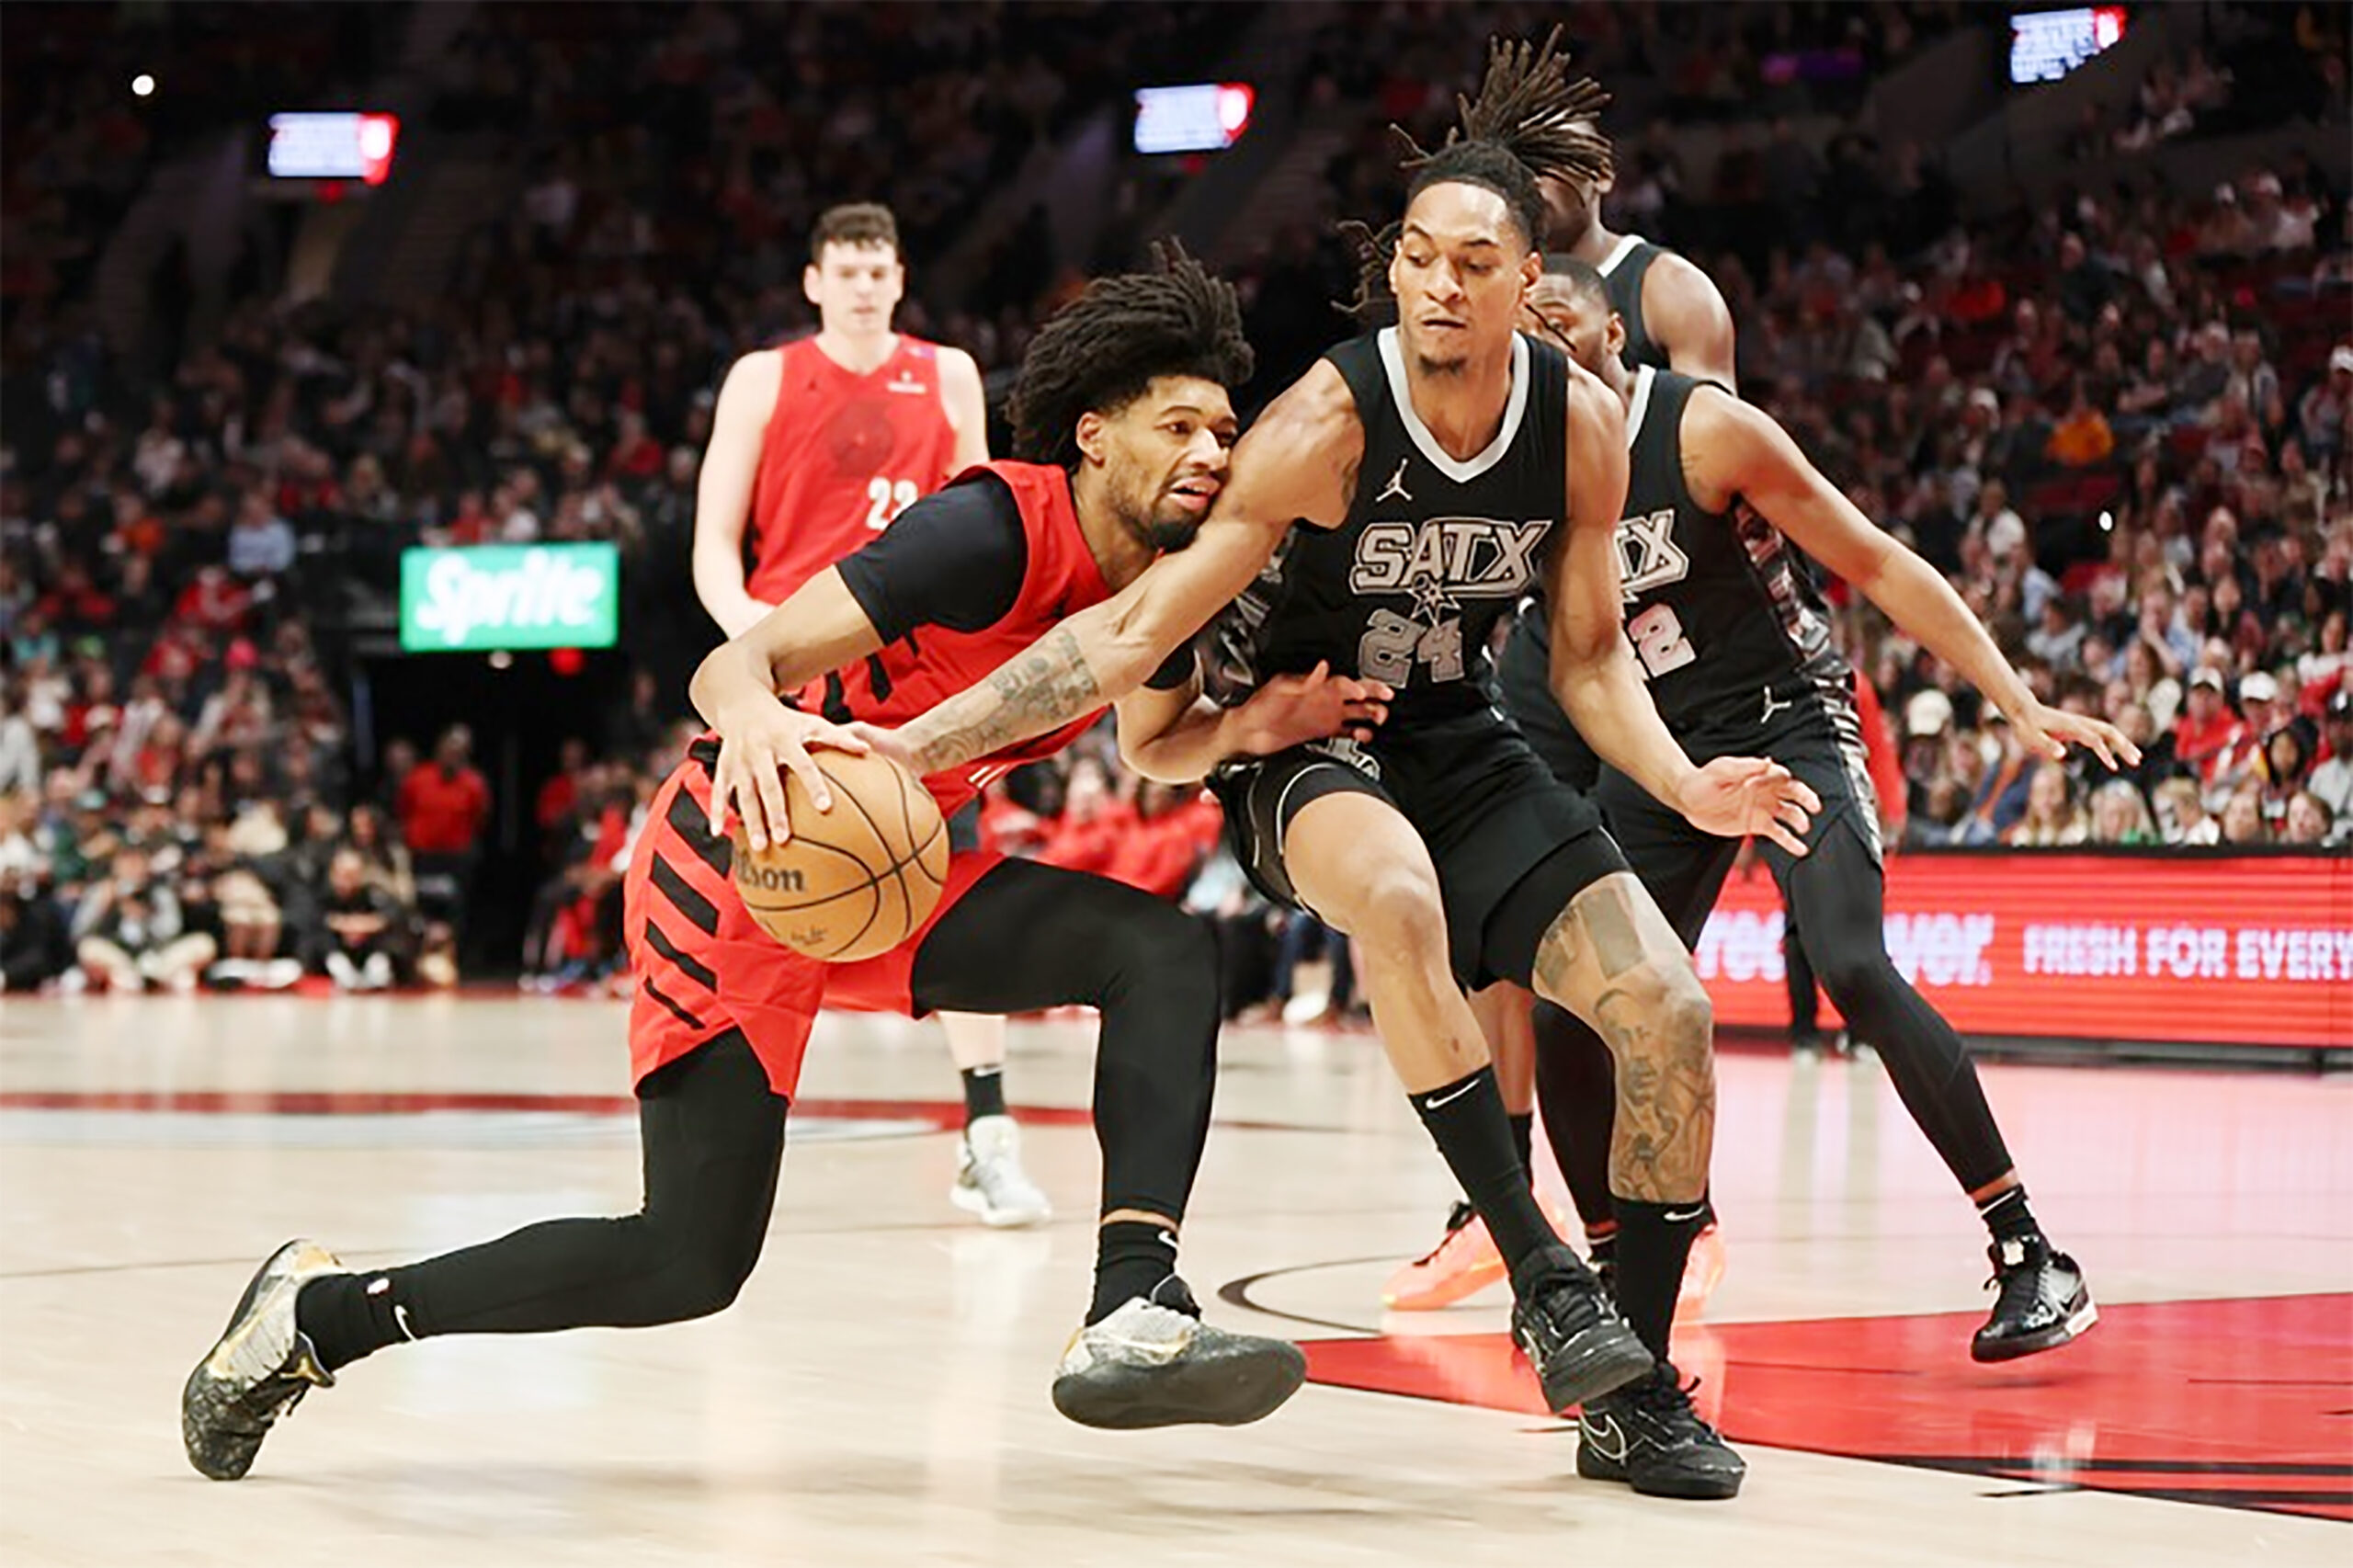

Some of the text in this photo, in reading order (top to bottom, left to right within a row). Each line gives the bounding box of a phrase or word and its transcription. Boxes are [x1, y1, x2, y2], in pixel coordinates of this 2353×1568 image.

[415, 549, 605, 645] Sprite
[1349, 517, 1553, 597] SATX
[1357, 608, 1465, 689] 24
[1626, 603, 1697, 678] 2
[2023, 925, 2137, 976] FRESH
[2146, 926, 2228, 978] FOR
